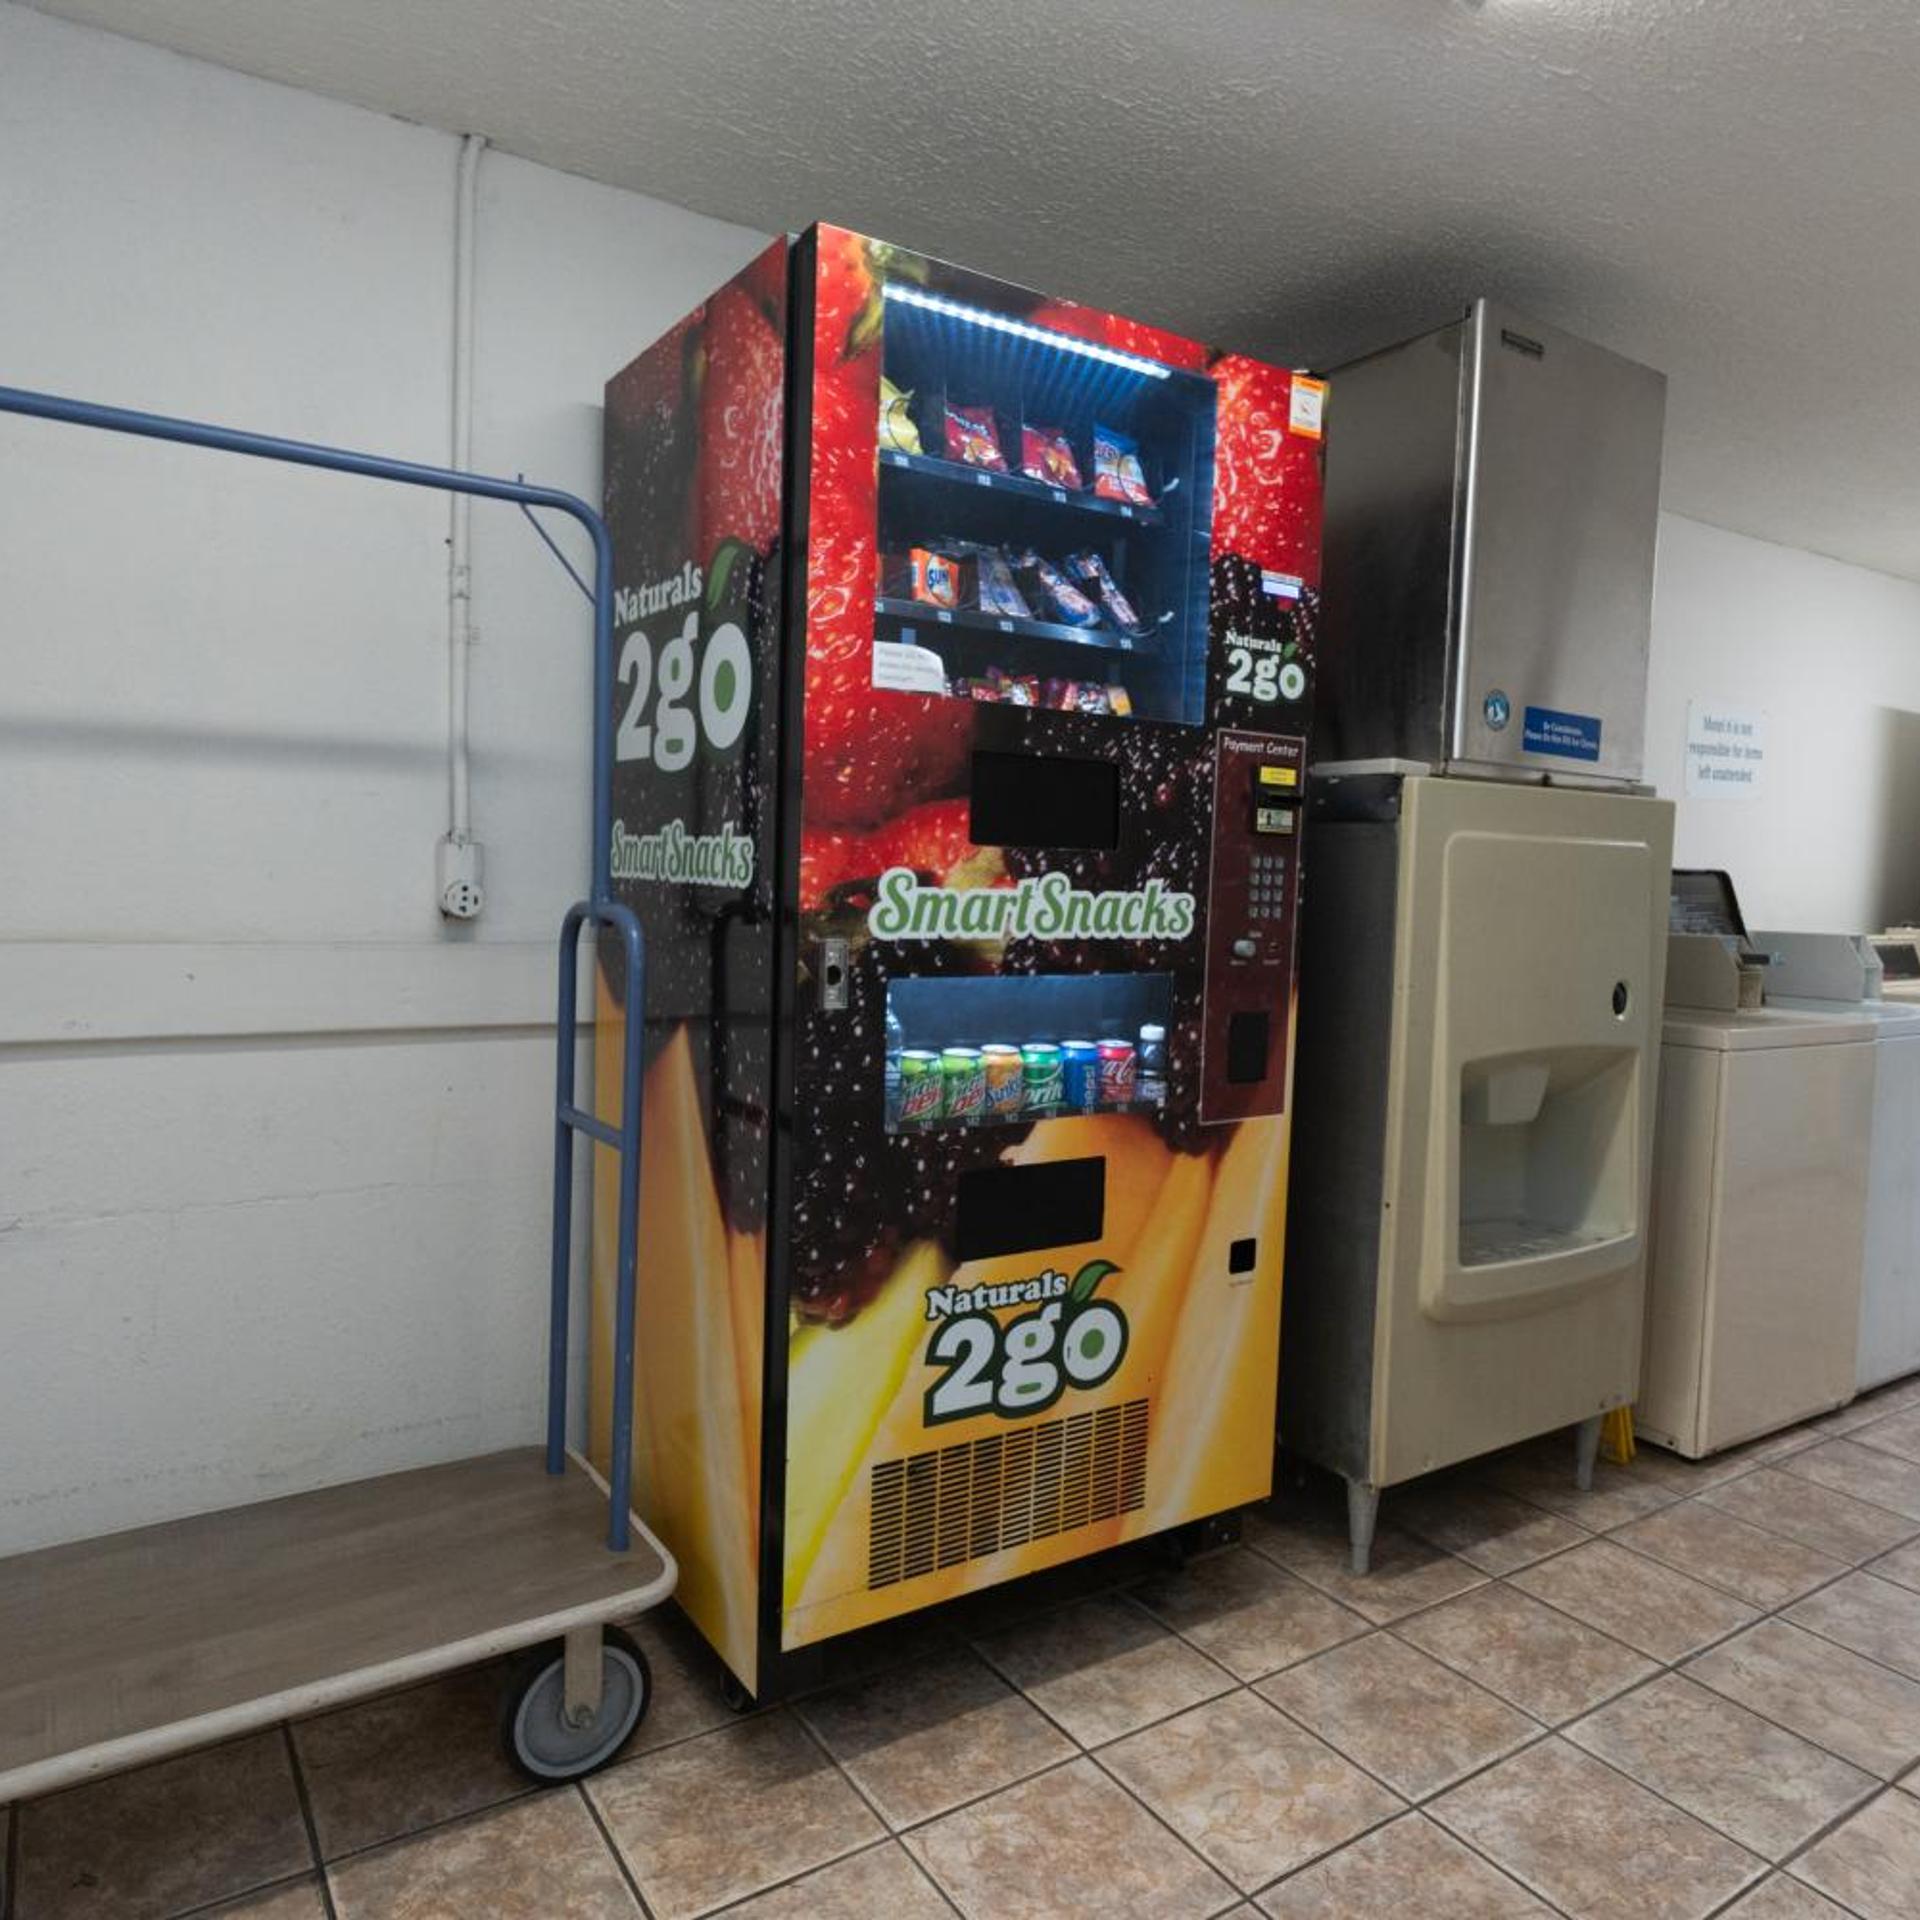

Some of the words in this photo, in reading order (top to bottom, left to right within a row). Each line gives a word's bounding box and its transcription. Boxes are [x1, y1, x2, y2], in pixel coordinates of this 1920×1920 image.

[614, 561, 703, 627] Naturals
[1224, 629, 1283, 653] Naturals
[615, 610, 752, 772] 2go
[1226, 647, 1305, 702] 2go
[1223, 737, 1264, 754] Payment
[1266, 742, 1299, 758] Center
[610, 818, 754, 889] SmartSnacks
[869, 868, 1195, 939] SmartSnacks
[926, 1271, 1067, 1319] Naturals
[930, 1300, 1125, 1418] 2go
